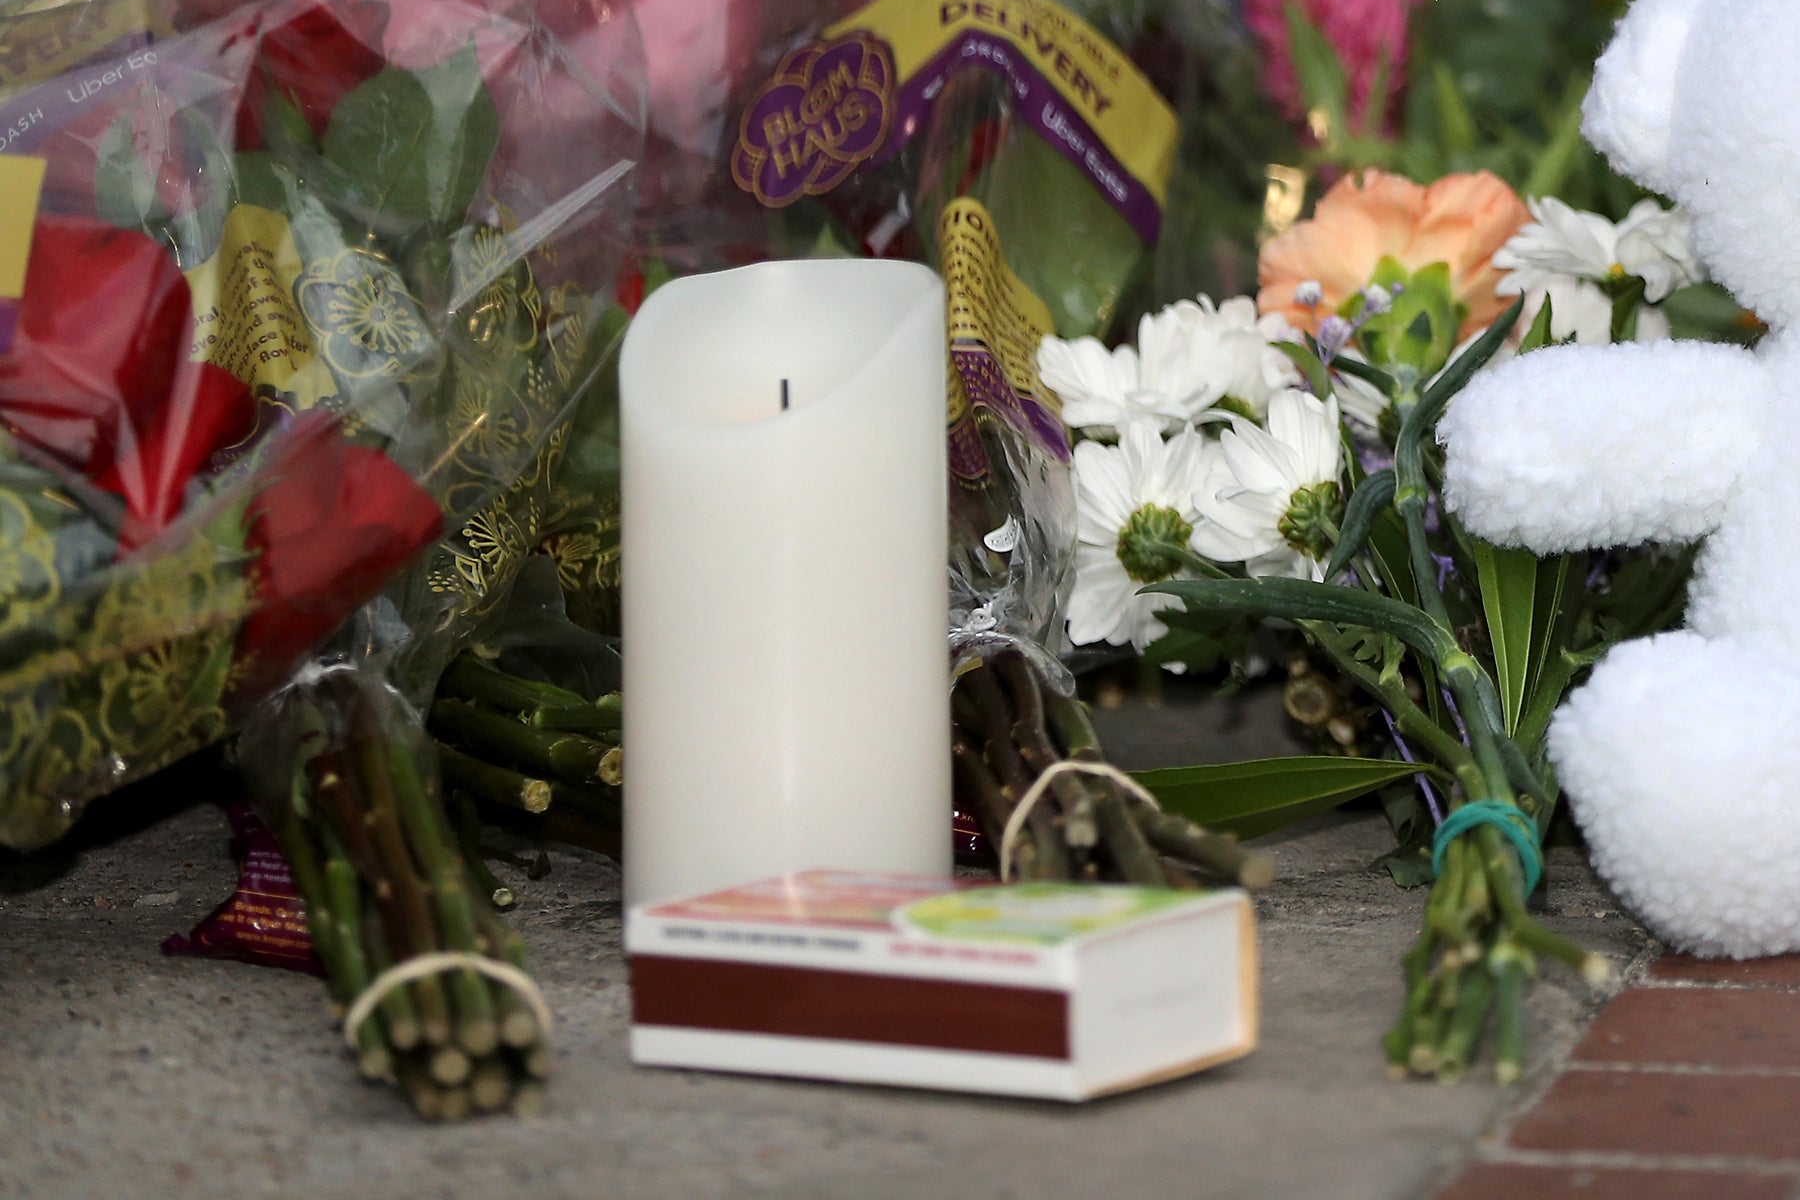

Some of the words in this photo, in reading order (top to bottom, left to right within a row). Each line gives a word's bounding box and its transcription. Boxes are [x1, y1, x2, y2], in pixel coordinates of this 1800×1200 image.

[66, 64, 124, 104] Uber
[771, 90, 868, 180] HAUS
[1041, 100, 1087, 154] Uber
